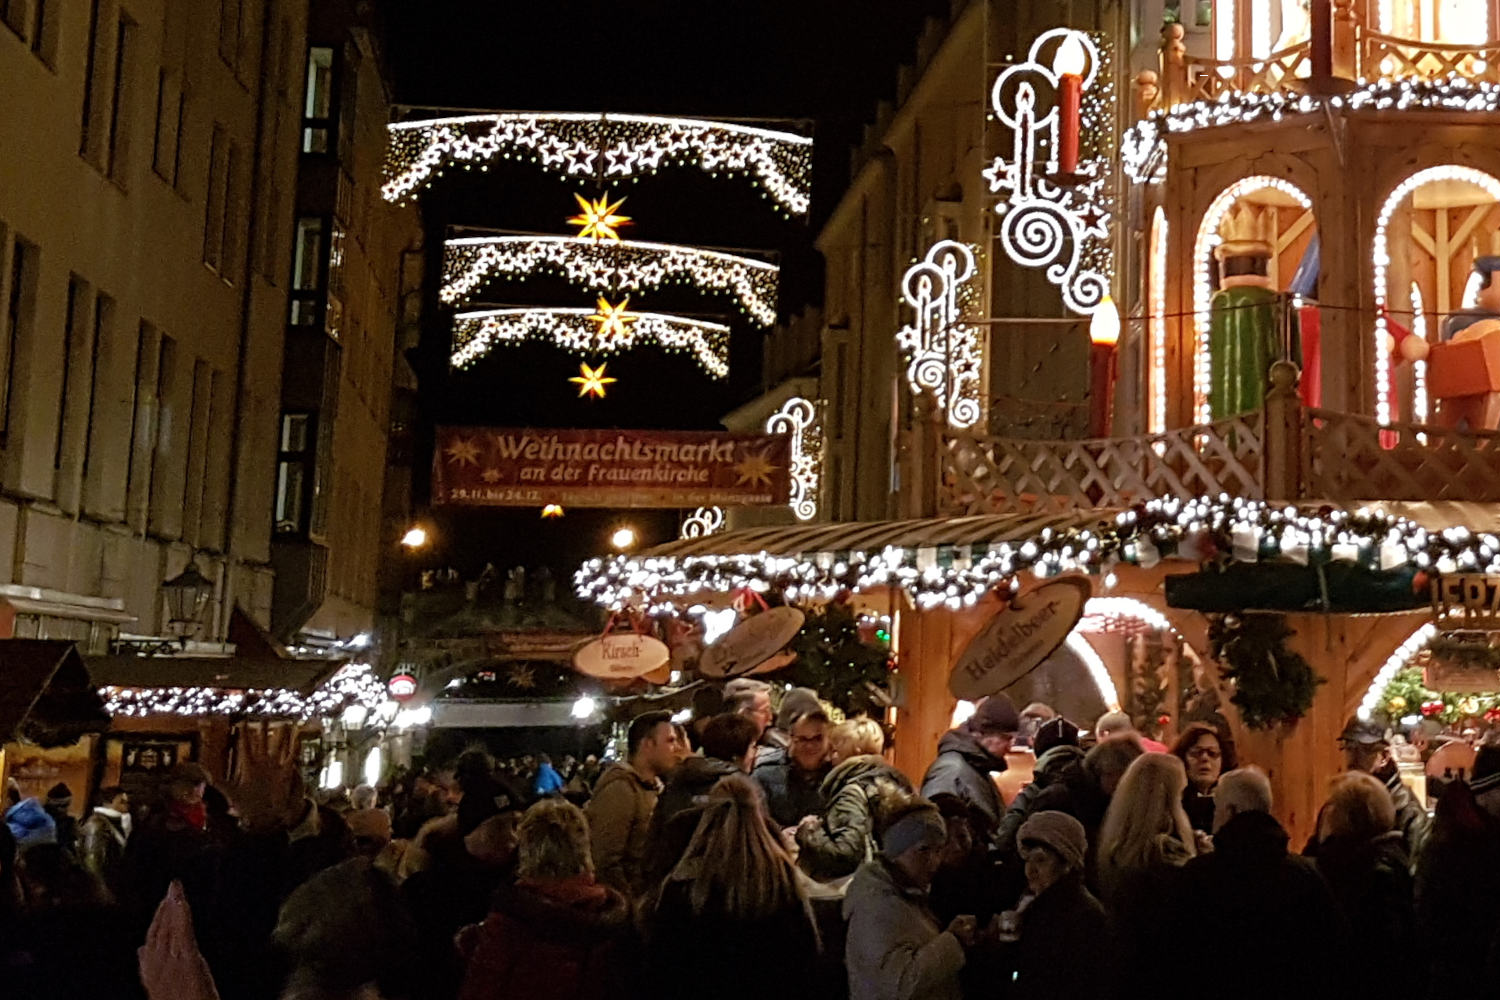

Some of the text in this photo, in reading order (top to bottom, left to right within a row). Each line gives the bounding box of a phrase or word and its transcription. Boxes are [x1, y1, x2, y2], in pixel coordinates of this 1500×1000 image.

[497, 434, 736, 463] Weihnachtsmarkt
[520, 463, 710, 482] an der Frauenkirche
